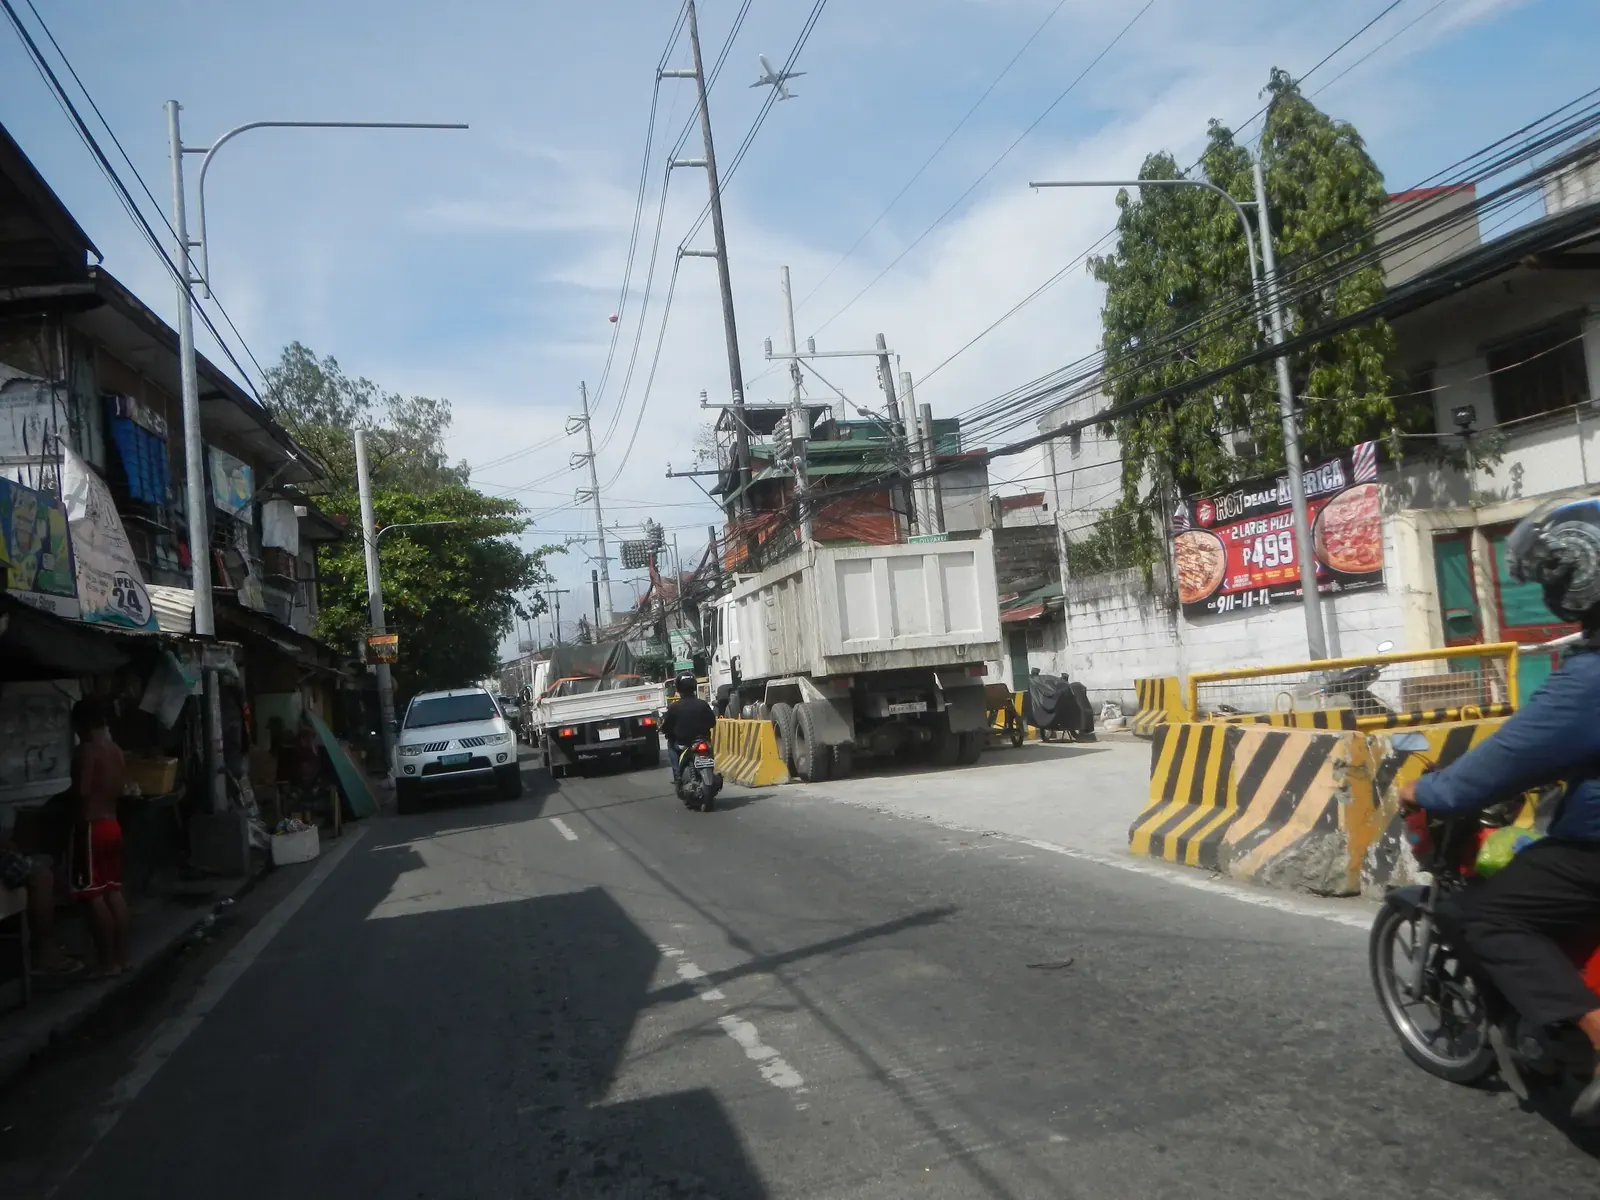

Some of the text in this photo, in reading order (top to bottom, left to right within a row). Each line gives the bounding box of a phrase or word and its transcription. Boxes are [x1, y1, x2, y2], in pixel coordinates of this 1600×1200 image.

[1213, 489, 1244, 521] HOT
[1244, 488, 1277, 508] DEALS
[1231, 526, 1239, 540] 2
[1239, 519, 1268, 538] LARGE
[112, 587, 143, 613] 24
[1216, 588, 1270, 614] 911-11-11
